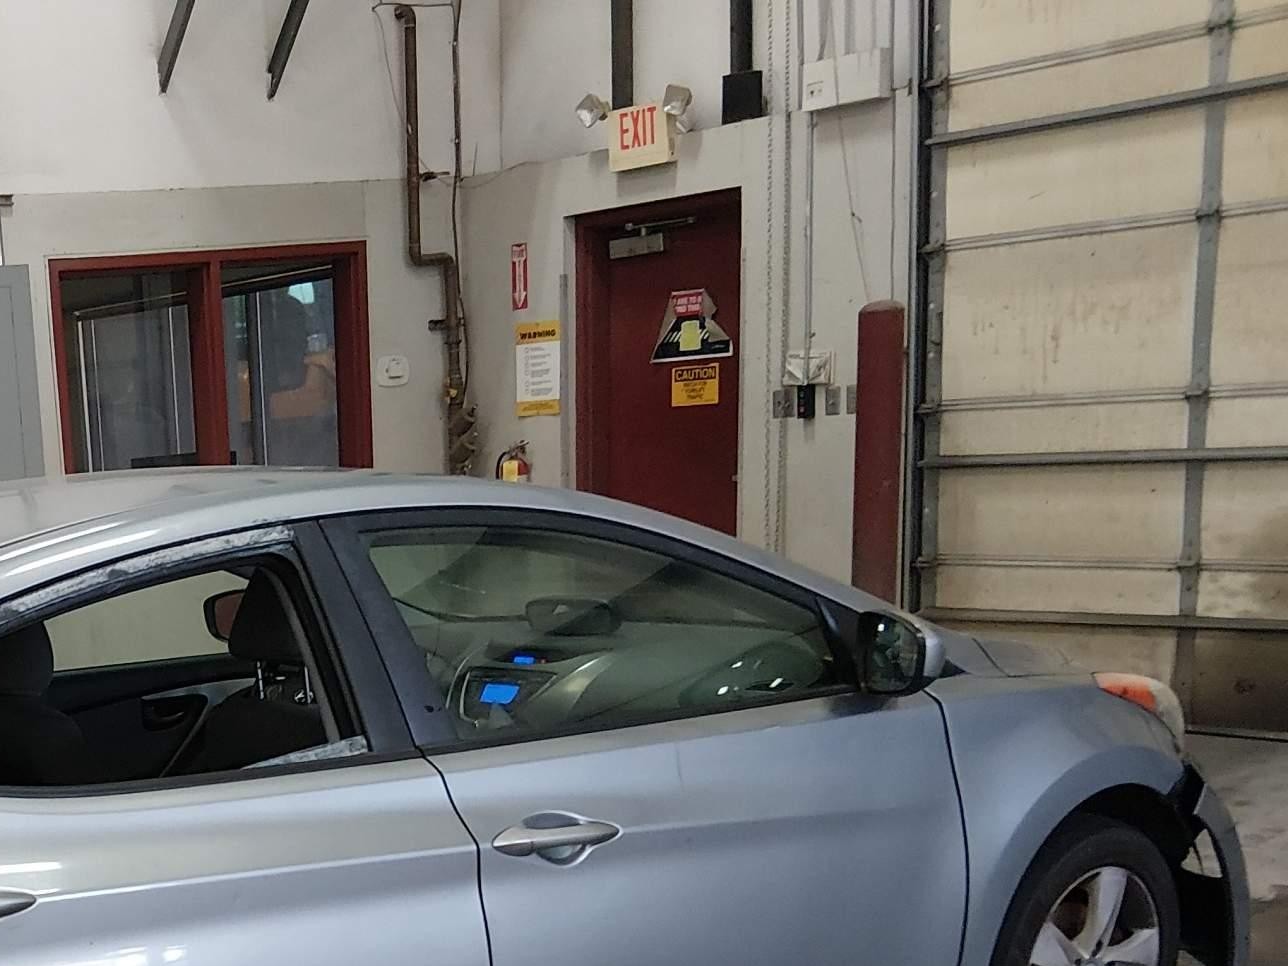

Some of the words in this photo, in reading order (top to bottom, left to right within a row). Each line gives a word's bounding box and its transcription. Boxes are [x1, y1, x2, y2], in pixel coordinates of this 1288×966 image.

[619, 106, 657, 150] EXIT
[519, 329, 556, 340] WARNING
[675, 367, 716, 381] CAUTION
